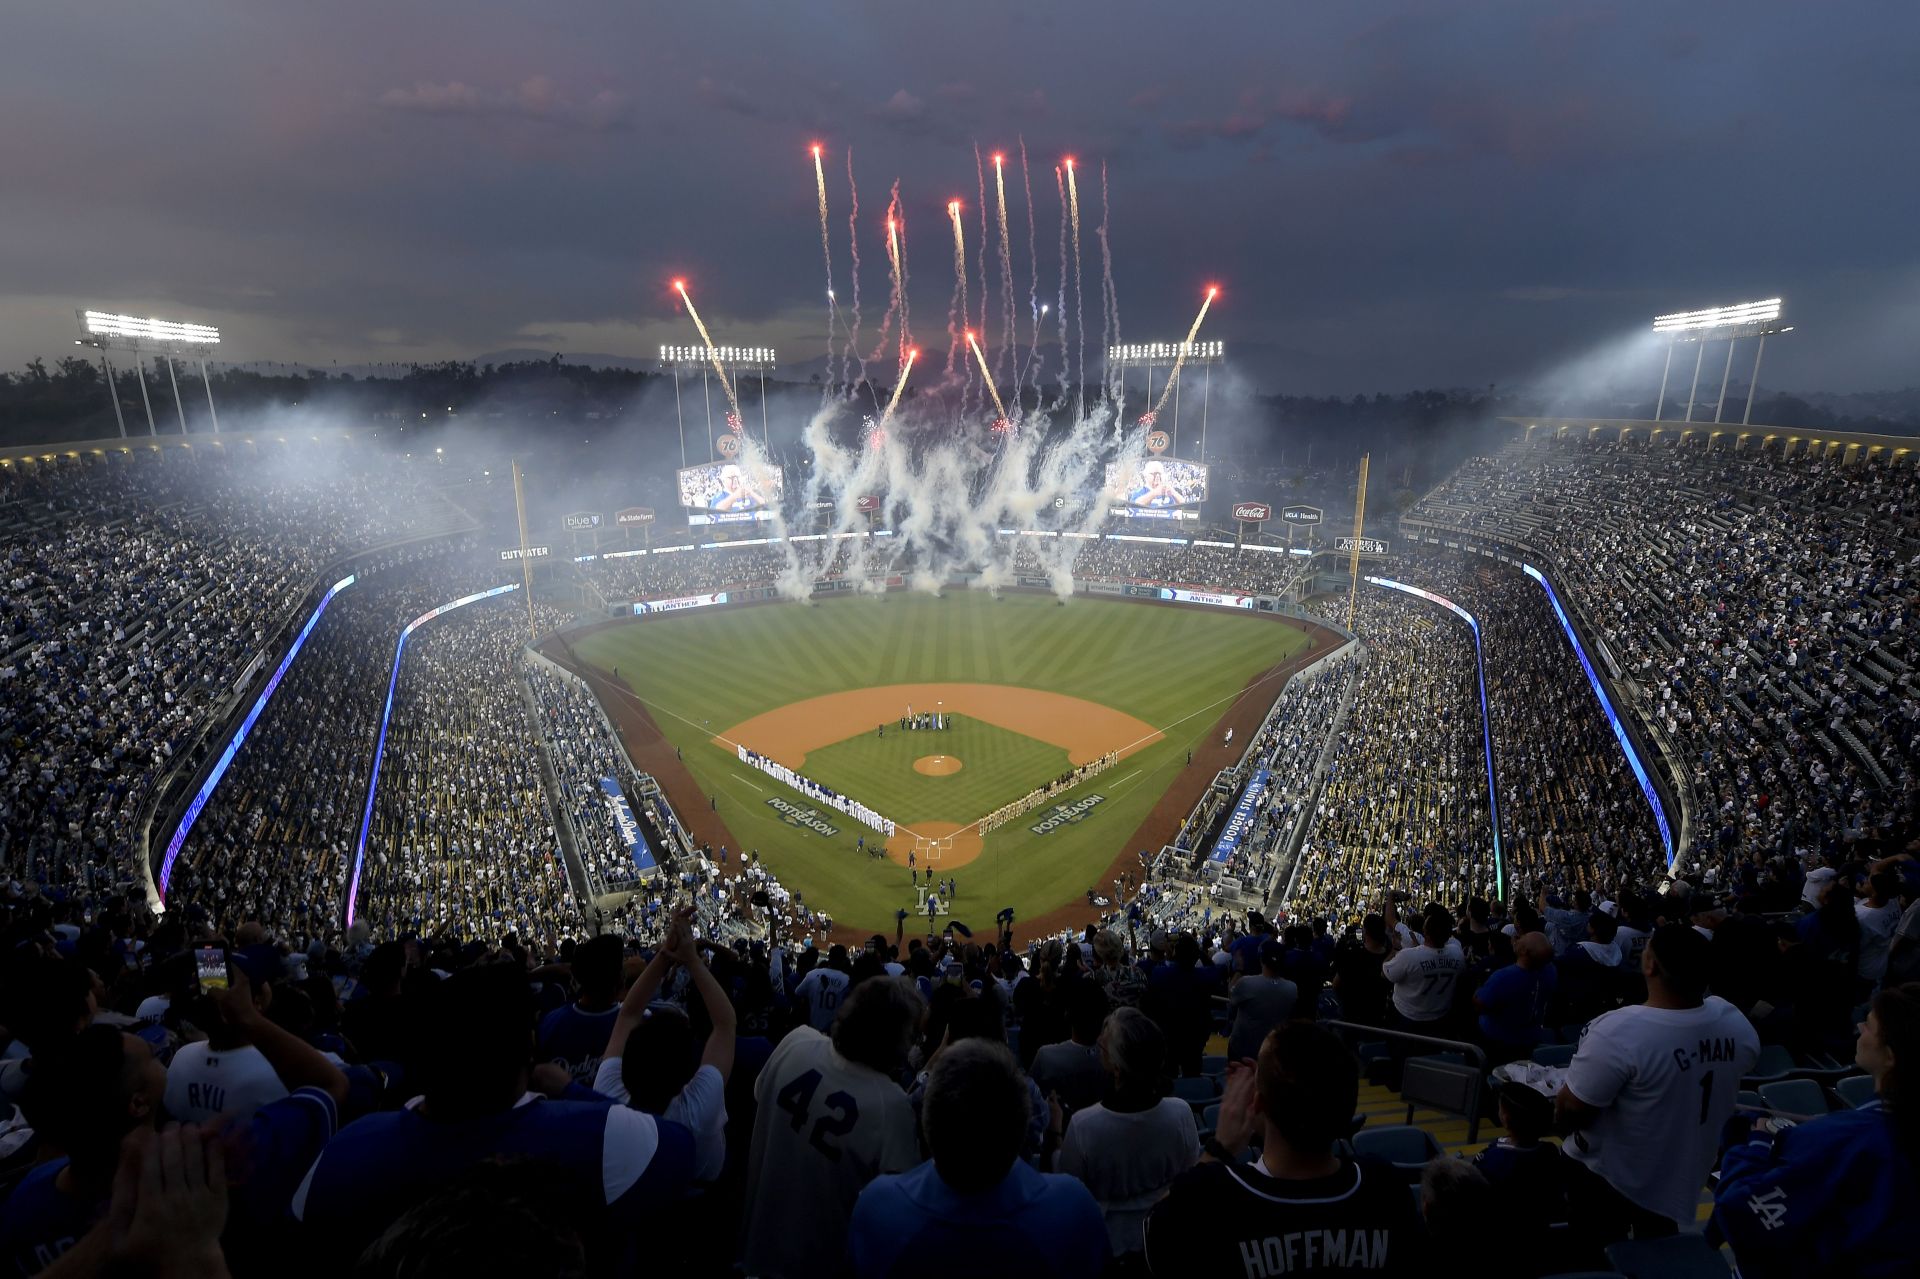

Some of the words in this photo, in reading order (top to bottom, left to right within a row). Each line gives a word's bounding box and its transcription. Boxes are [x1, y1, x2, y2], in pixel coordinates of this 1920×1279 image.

[1150, 435, 1165, 448] 76
[567, 516, 590, 526] blue
[1300, 512, 1319, 520] Health
[501, 547, 548, 560] CUTWATER
[665, 600, 698, 609] ANTHEM
[1189, 595, 1223, 604] ANTHEM
[767, 797, 838, 836] POSTSEASON
[1031, 794, 1105, 835] POSTSEASON
[1223, 811, 1248, 842] DODGER
[914, 886, 949, 916] LA
[1420, 959, 1437, 972] FAN
[1438, 958, 1460, 970] SINCE
[1421, 973, 1455, 995] 77
[819, 991, 836, 1010] 10
[746, 1013, 769, 1030] 35
[1673, 1037, 1736, 1072] G-MAN
[188, 1083, 226, 1113] RYU
[1699, 1070, 1714, 1125] 1
[777, 1068, 858, 1162] 42
[1746, 1184, 1790, 1233] LA
[1238, 1226, 1392, 1279] HOFFMAN
